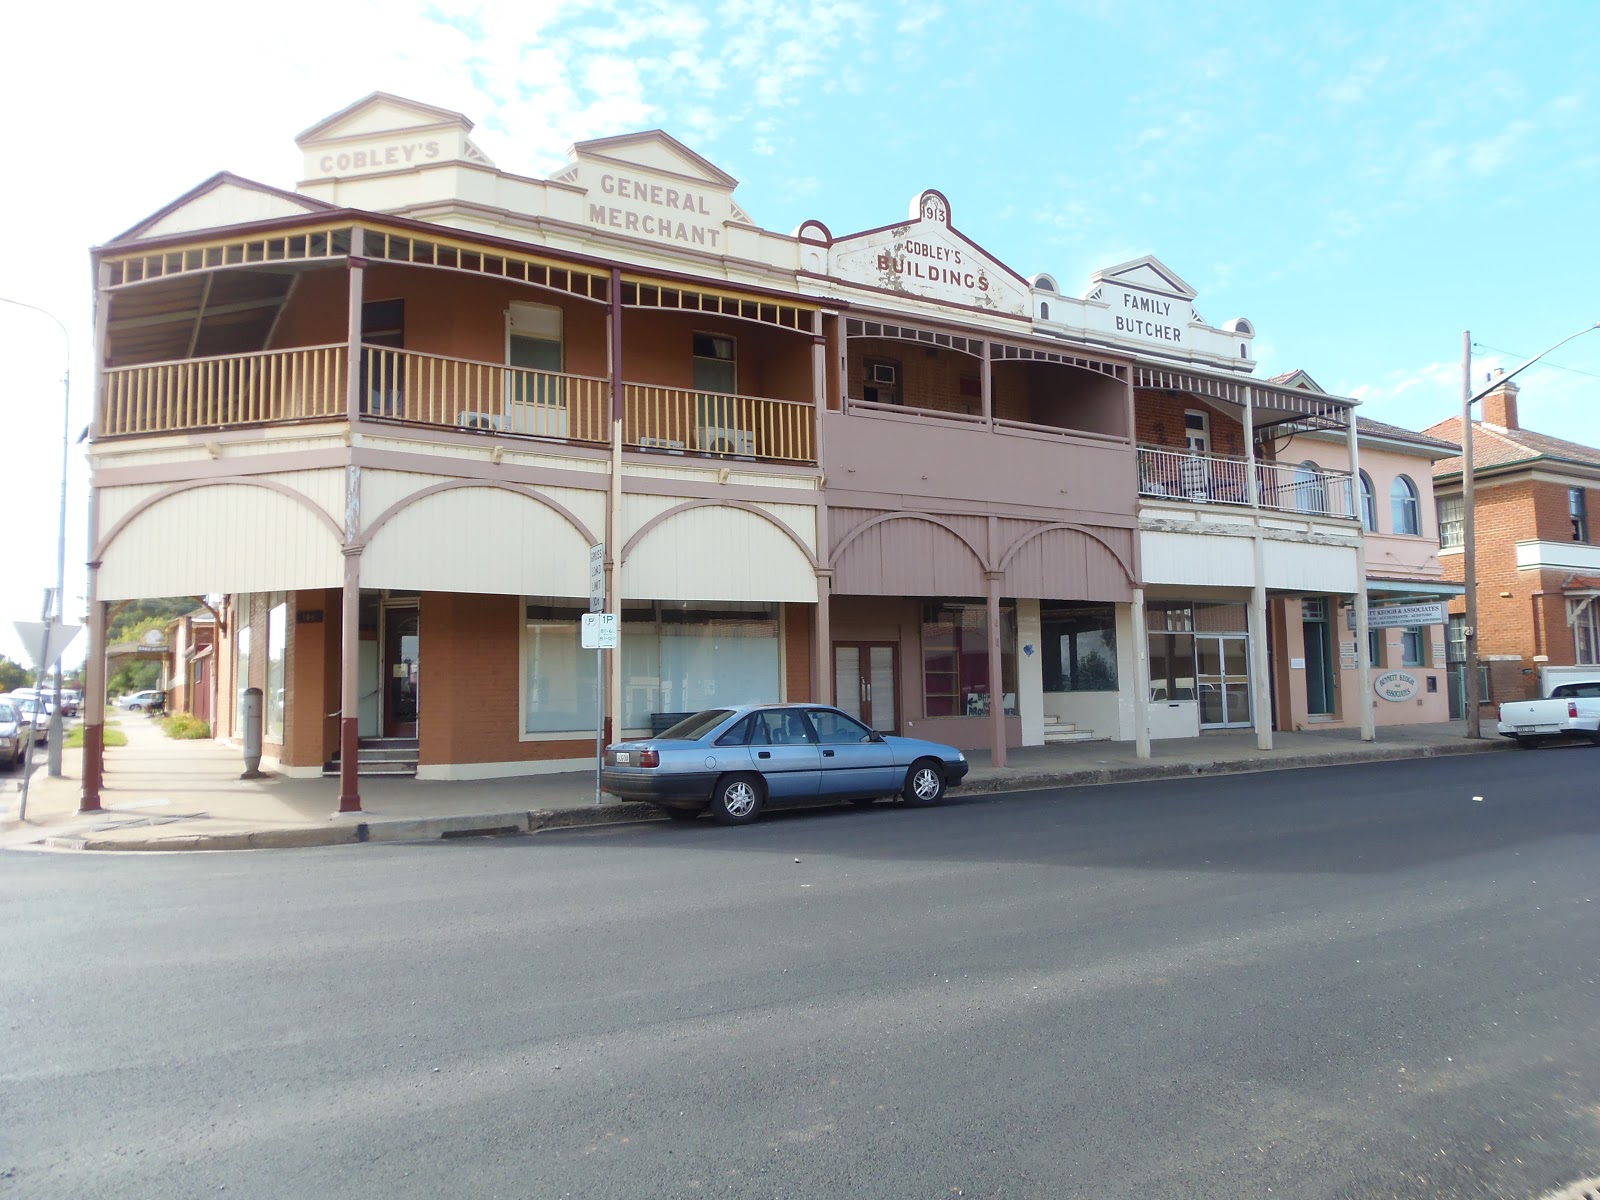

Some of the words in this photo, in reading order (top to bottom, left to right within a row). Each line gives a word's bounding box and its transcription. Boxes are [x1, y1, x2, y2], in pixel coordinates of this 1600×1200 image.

[320, 141, 440, 173] COBLEY'S
[601, 174, 710, 215] GENERAL
[590, 203, 720, 247] MERCHANT
[922, 205, 945, 222] 1913
[906, 239, 962, 264] COBLEY'S
[877, 254, 990, 291] BUILDINGS
[1123, 293, 1171, 316] FAMILY
[1115, 315, 1181, 342] BUTCHER
[603, 615, 614, 624] 1P
[1377, 608, 1397, 616] KEOGH
[1403, 605, 1439, 614] ASSOCIATES
